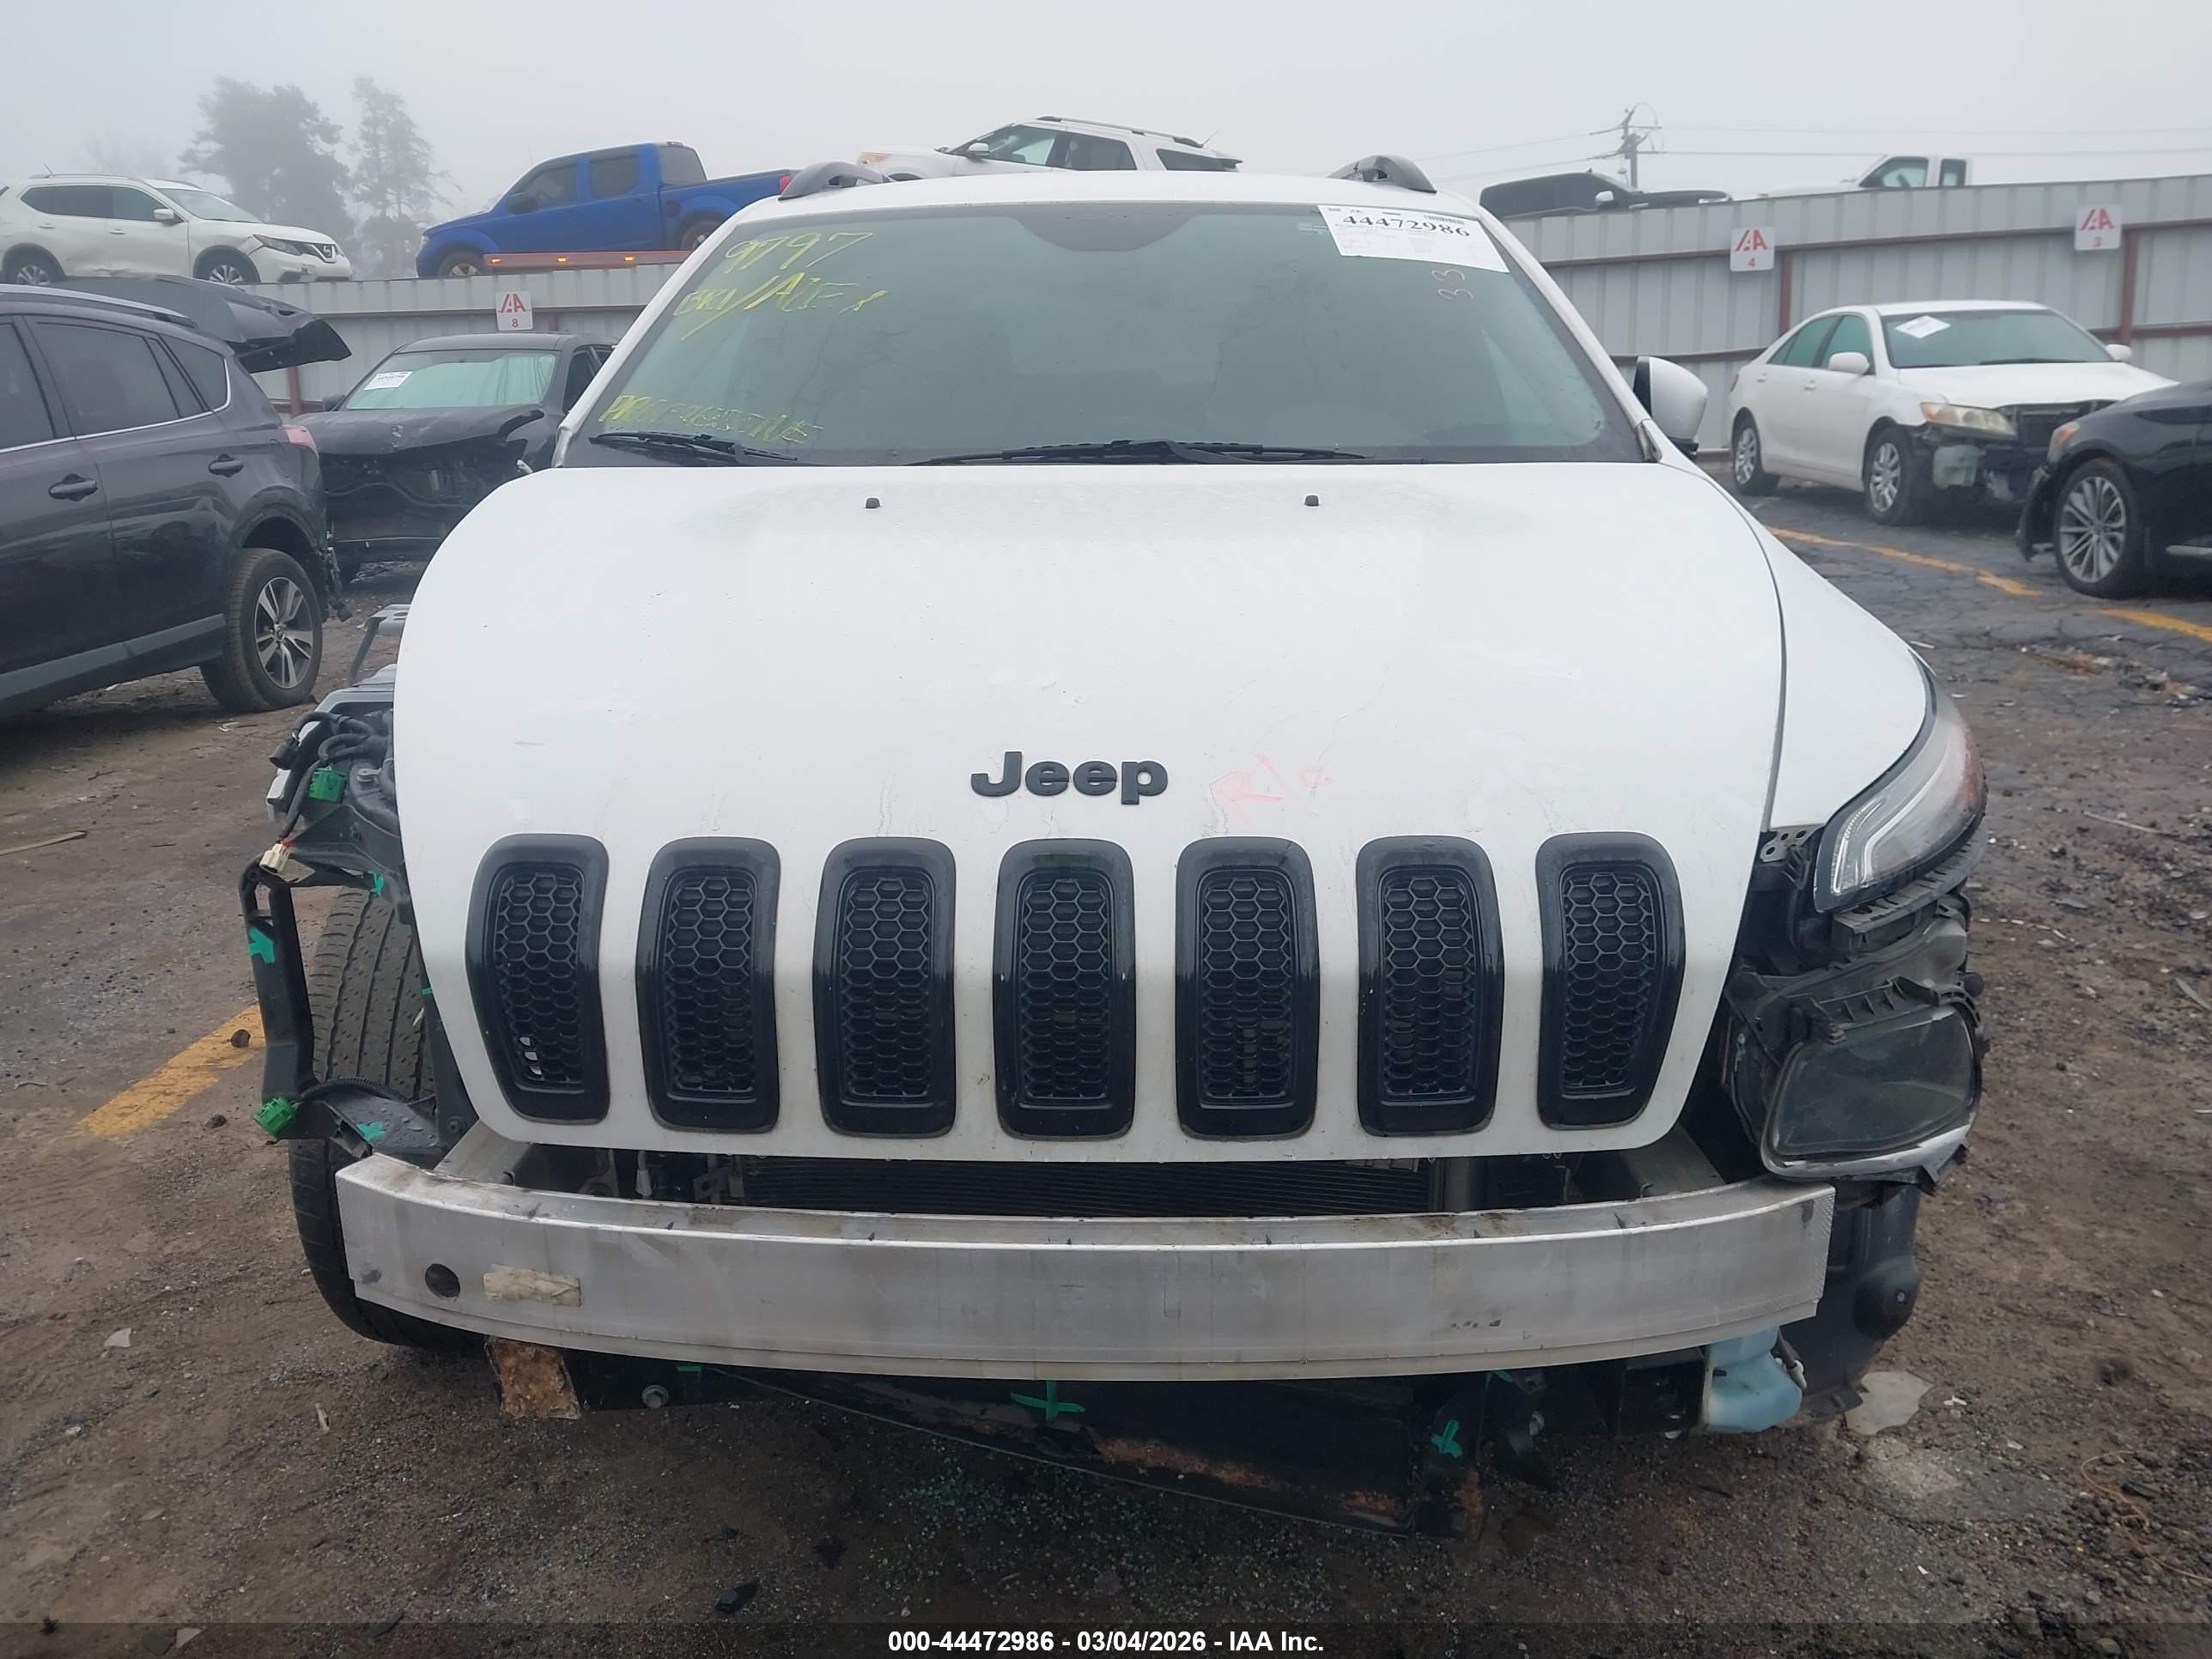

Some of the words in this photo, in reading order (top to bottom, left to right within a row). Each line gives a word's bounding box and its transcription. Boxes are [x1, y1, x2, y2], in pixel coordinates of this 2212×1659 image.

[1343, 215, 1470, 237] 44472986
[725, 233, 873, 274] 9797
[512, 318, 519, 327] 8
[971, 751, 1168, 805] Jeep
